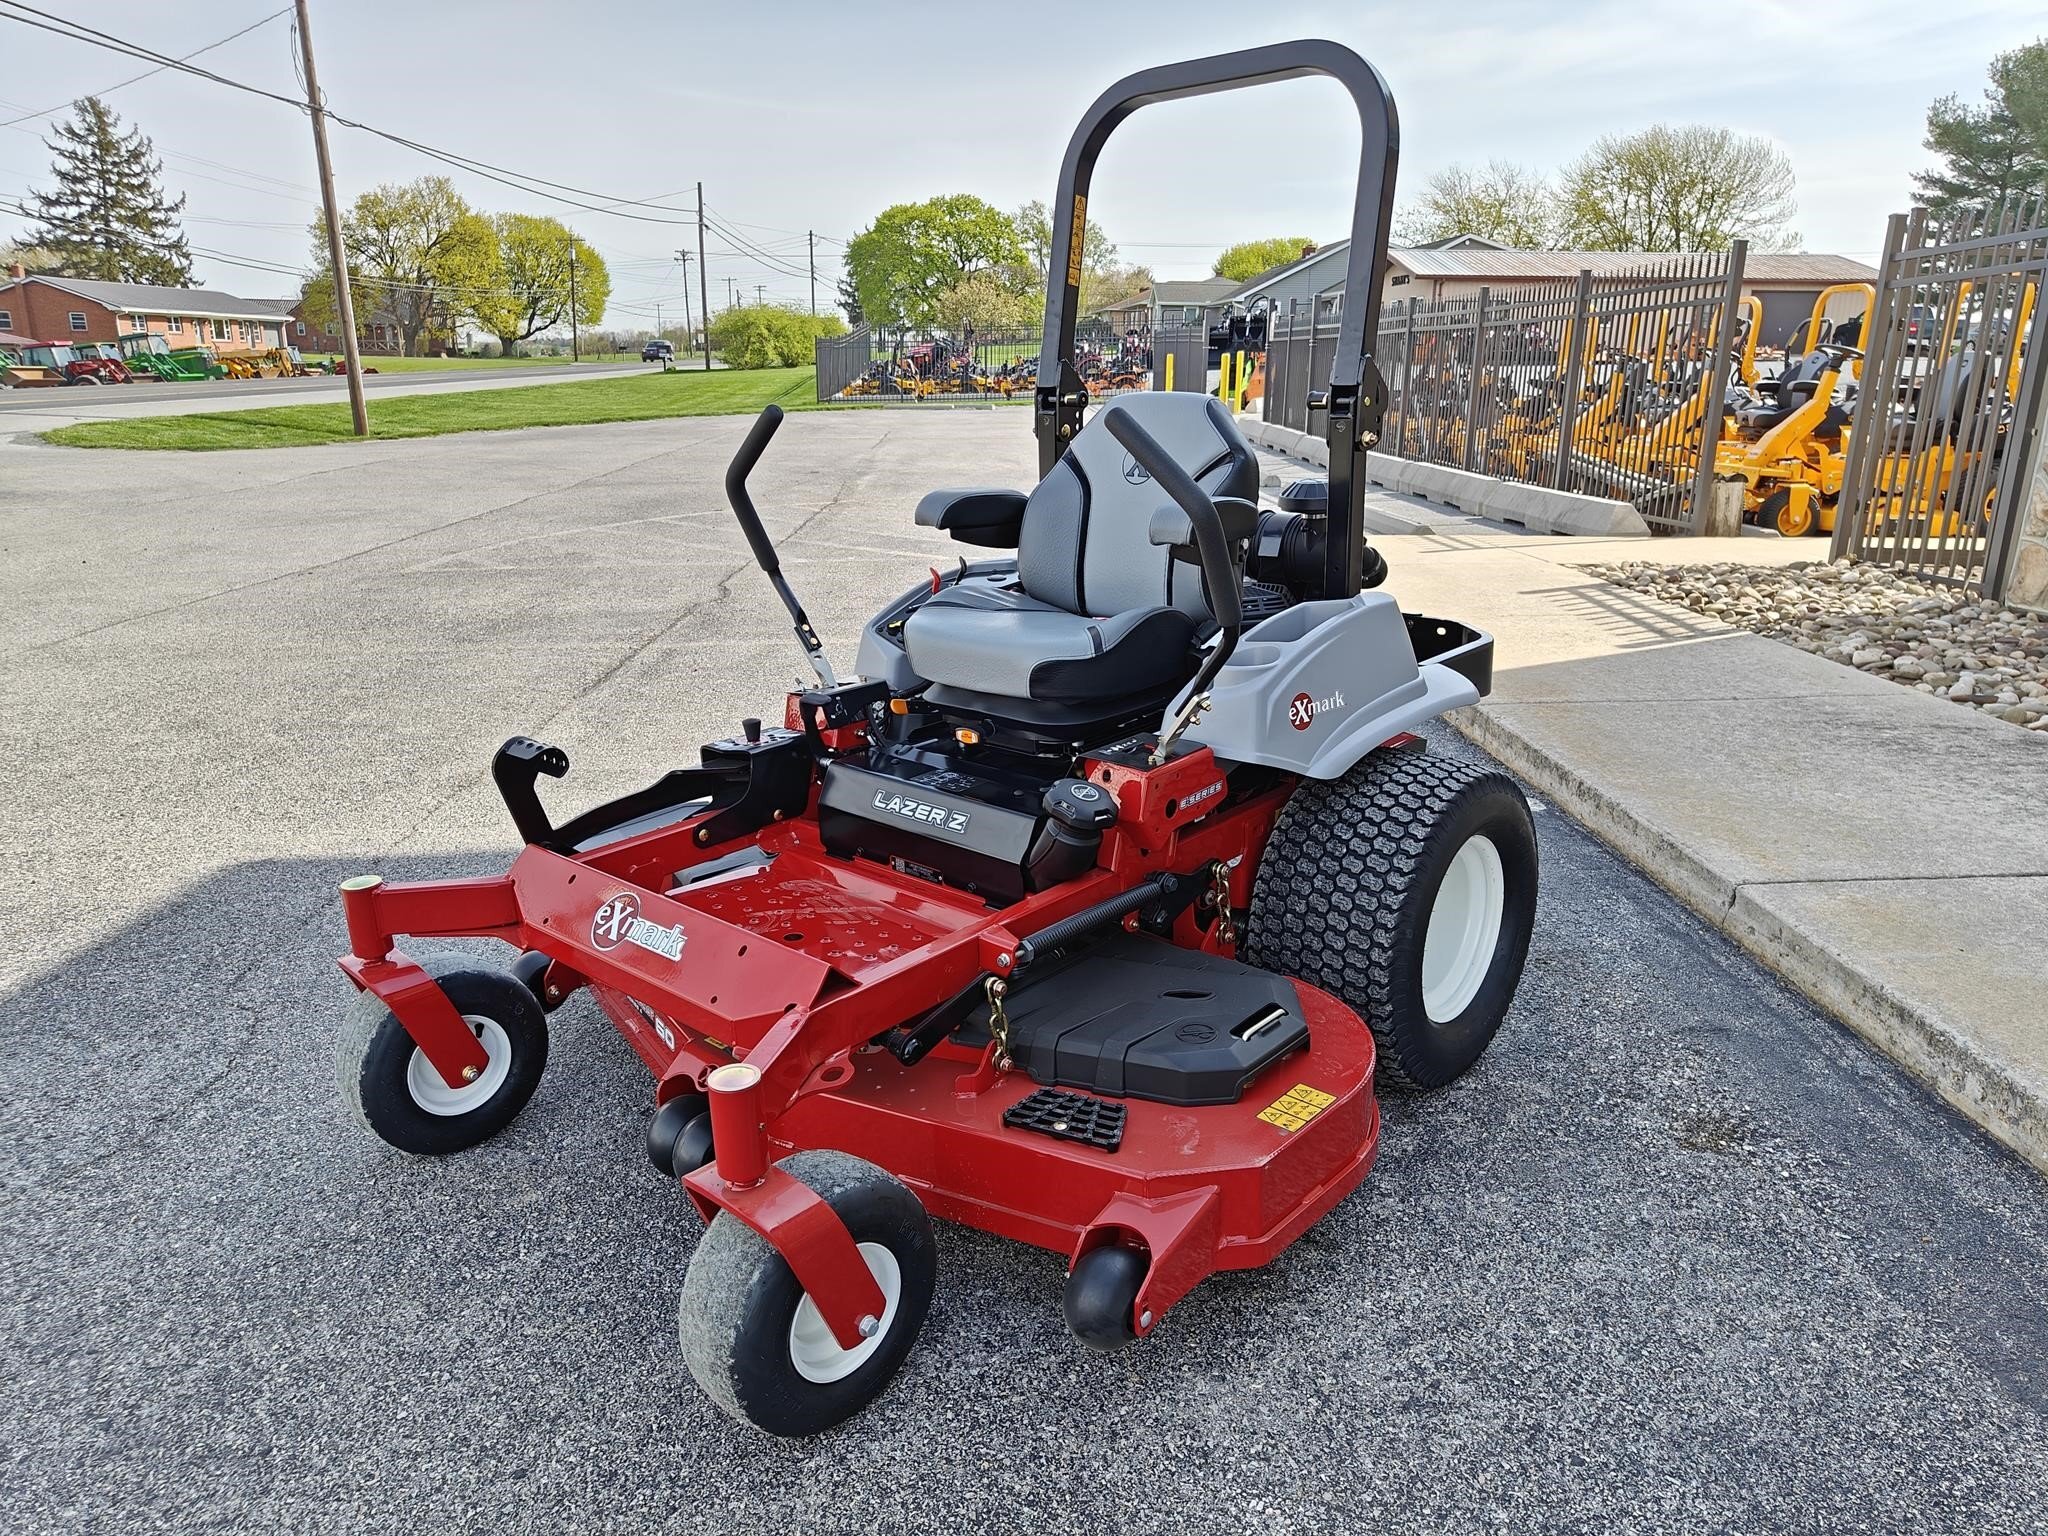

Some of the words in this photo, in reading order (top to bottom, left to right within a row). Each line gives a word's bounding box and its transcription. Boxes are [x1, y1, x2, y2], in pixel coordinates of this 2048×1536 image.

[1288, 690, 1345, 726] eXmark
[872, 790, 947, 828] LAZER
[946, 812, 969, 833] Z
[595, 899, 687, 959] eXmark
[655, 1015, 676, 1053] 60
